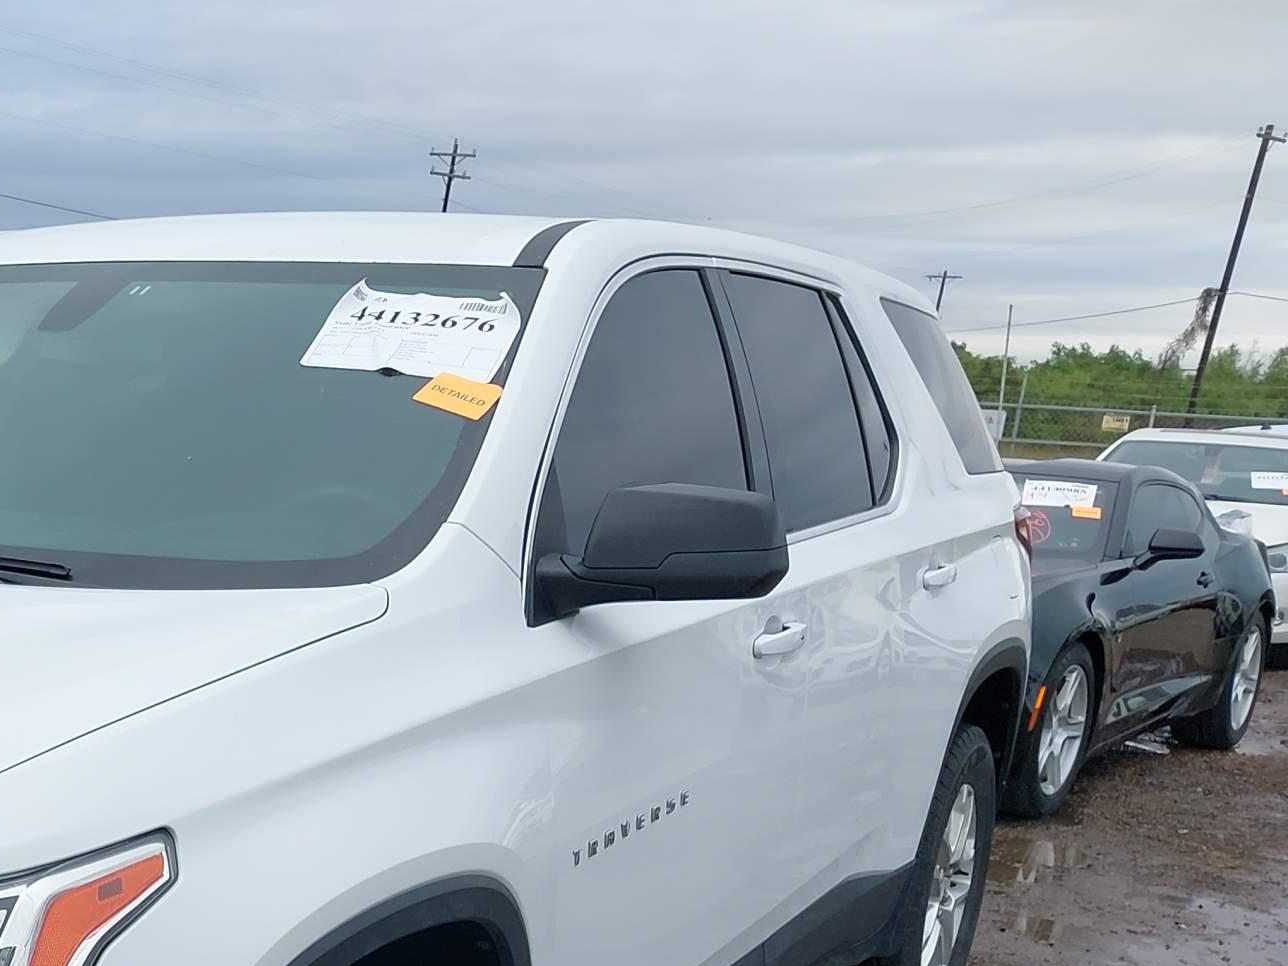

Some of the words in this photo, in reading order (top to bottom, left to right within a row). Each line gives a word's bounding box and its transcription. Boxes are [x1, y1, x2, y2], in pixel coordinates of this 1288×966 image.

[349, 305, 500, 333] 44132676
[431, 384, 486, 407] DETAILED
[571, 789, 690, 867] TRAVERSE
